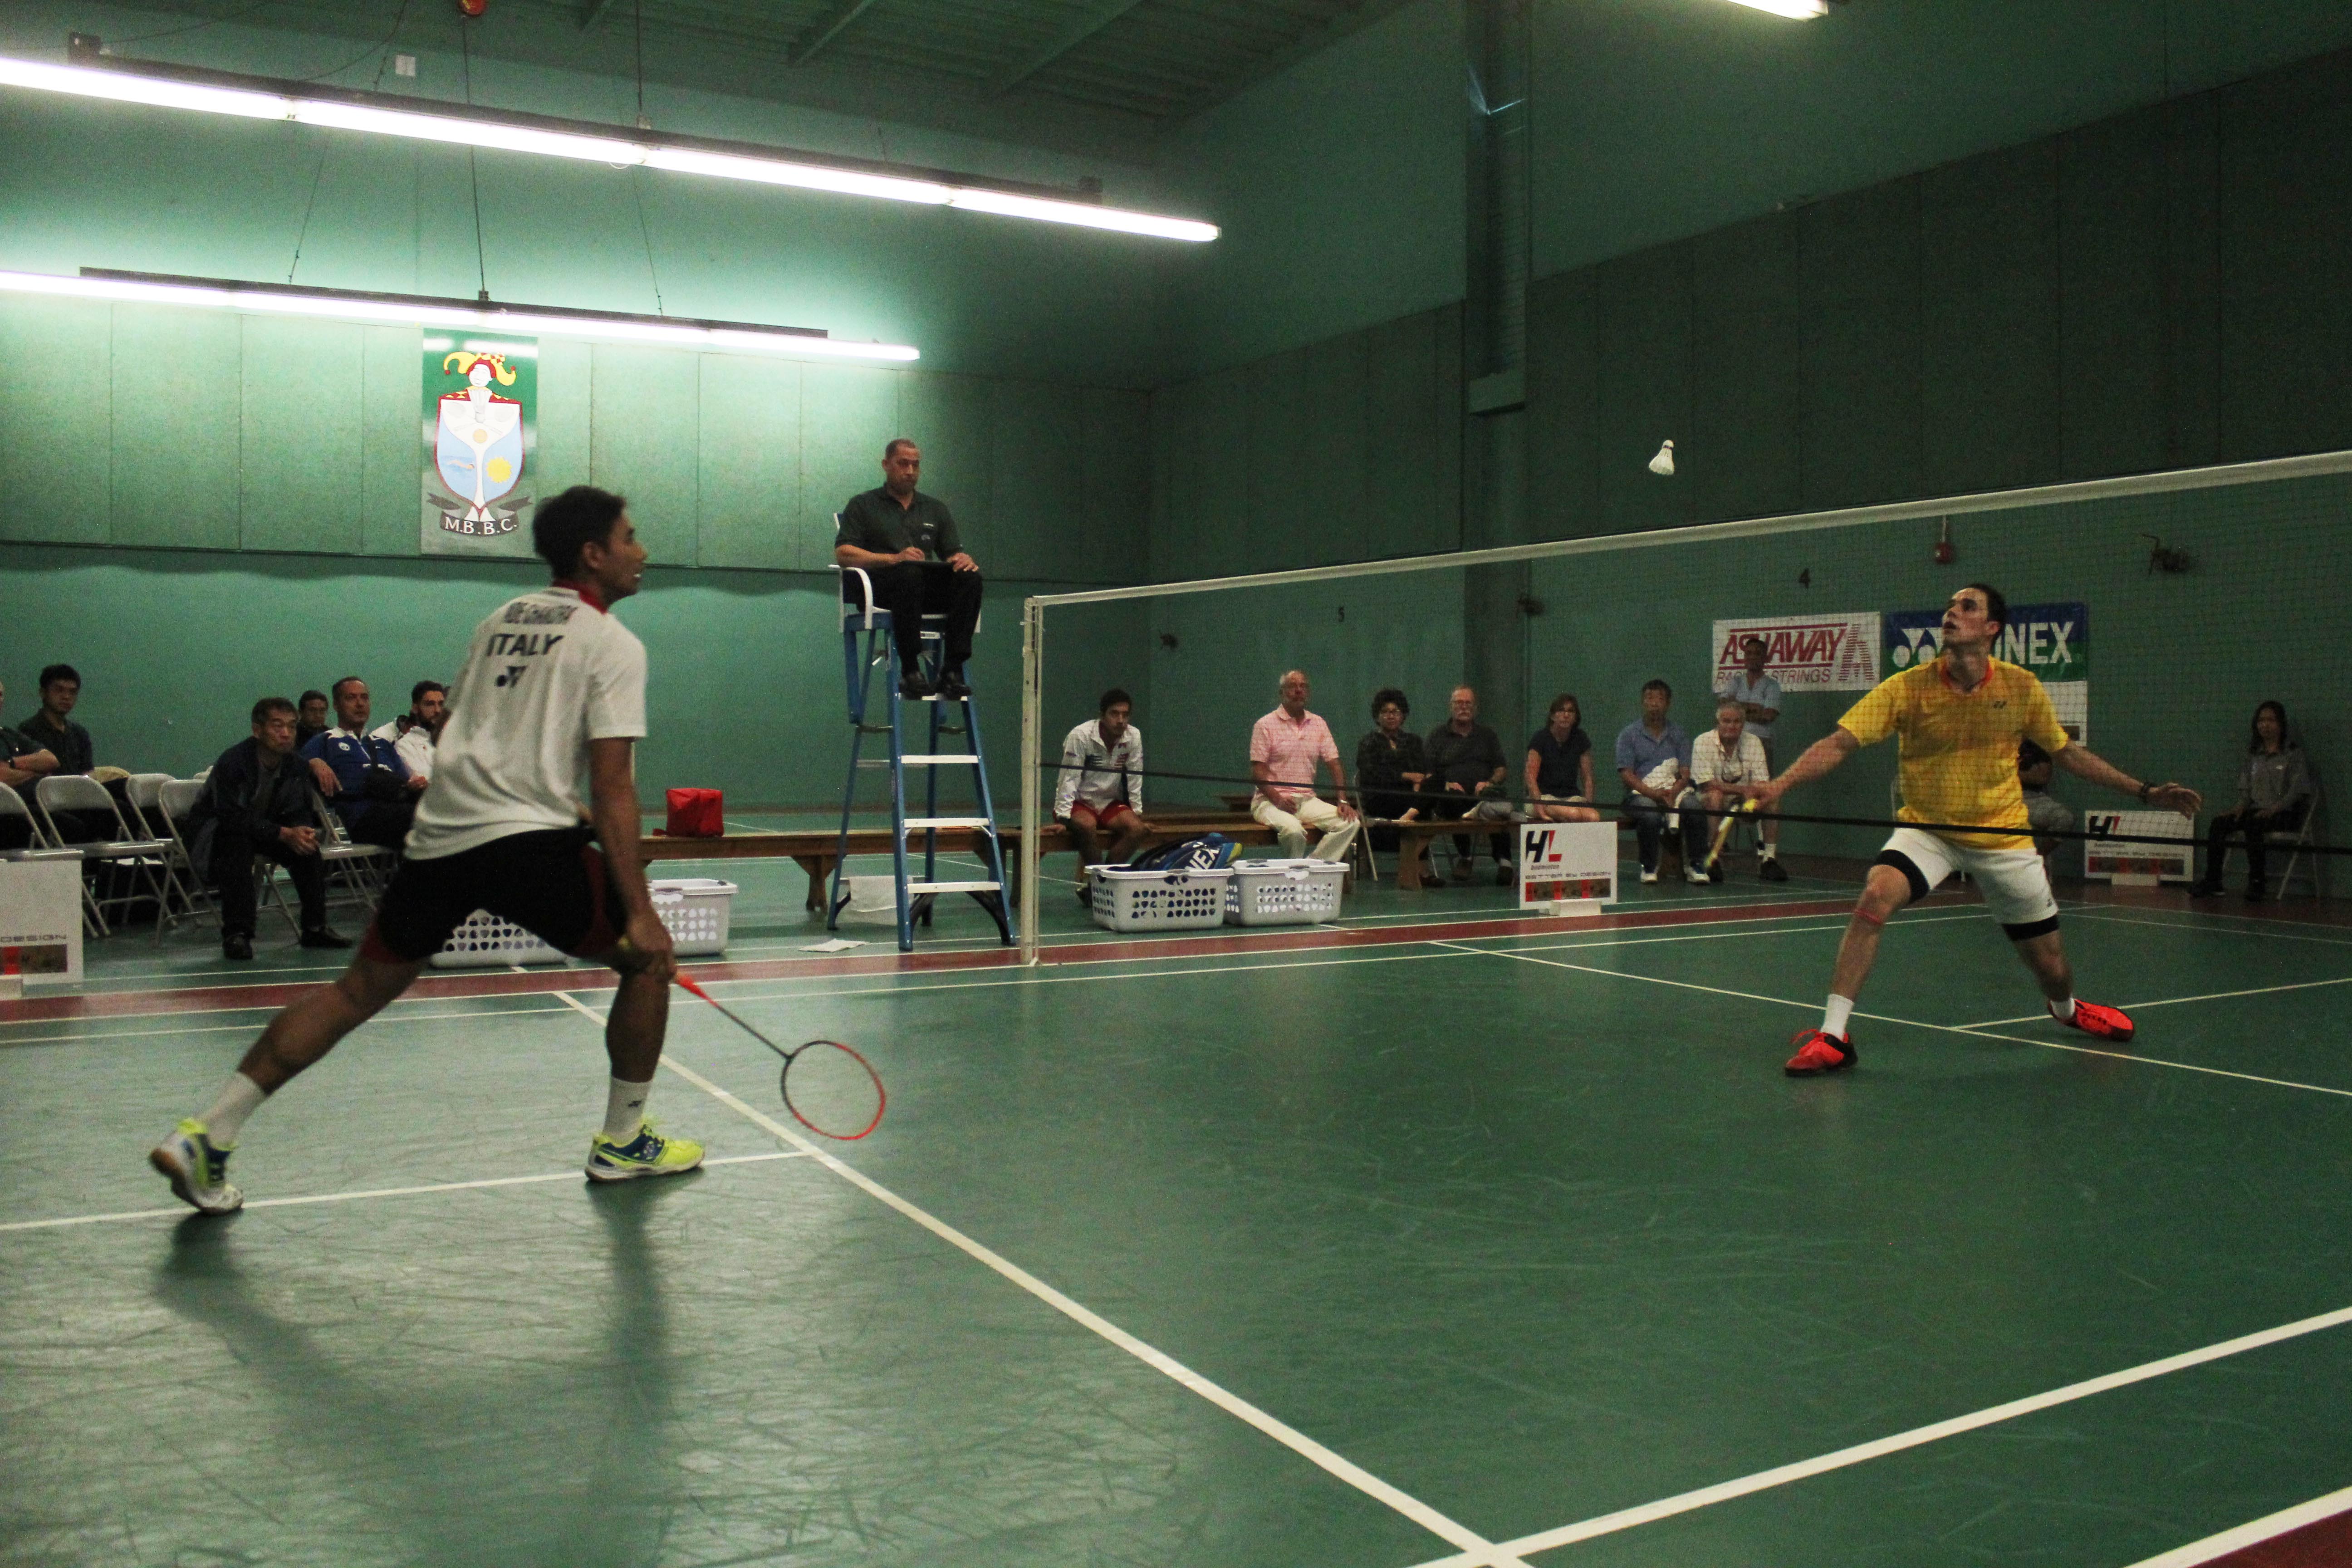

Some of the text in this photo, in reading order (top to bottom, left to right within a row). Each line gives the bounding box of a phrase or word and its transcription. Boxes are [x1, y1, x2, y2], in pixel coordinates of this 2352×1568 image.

[487, 633, 564, 657] ITALY
[1994, 621, 2074, 665] NEX
[1771, 668, 1831, 683] STRINGS
[1525, 829, 1562, 863] HL
[1185, 849, 1220, 870] NEX
[0, 934, 67, 942] DESIGN
